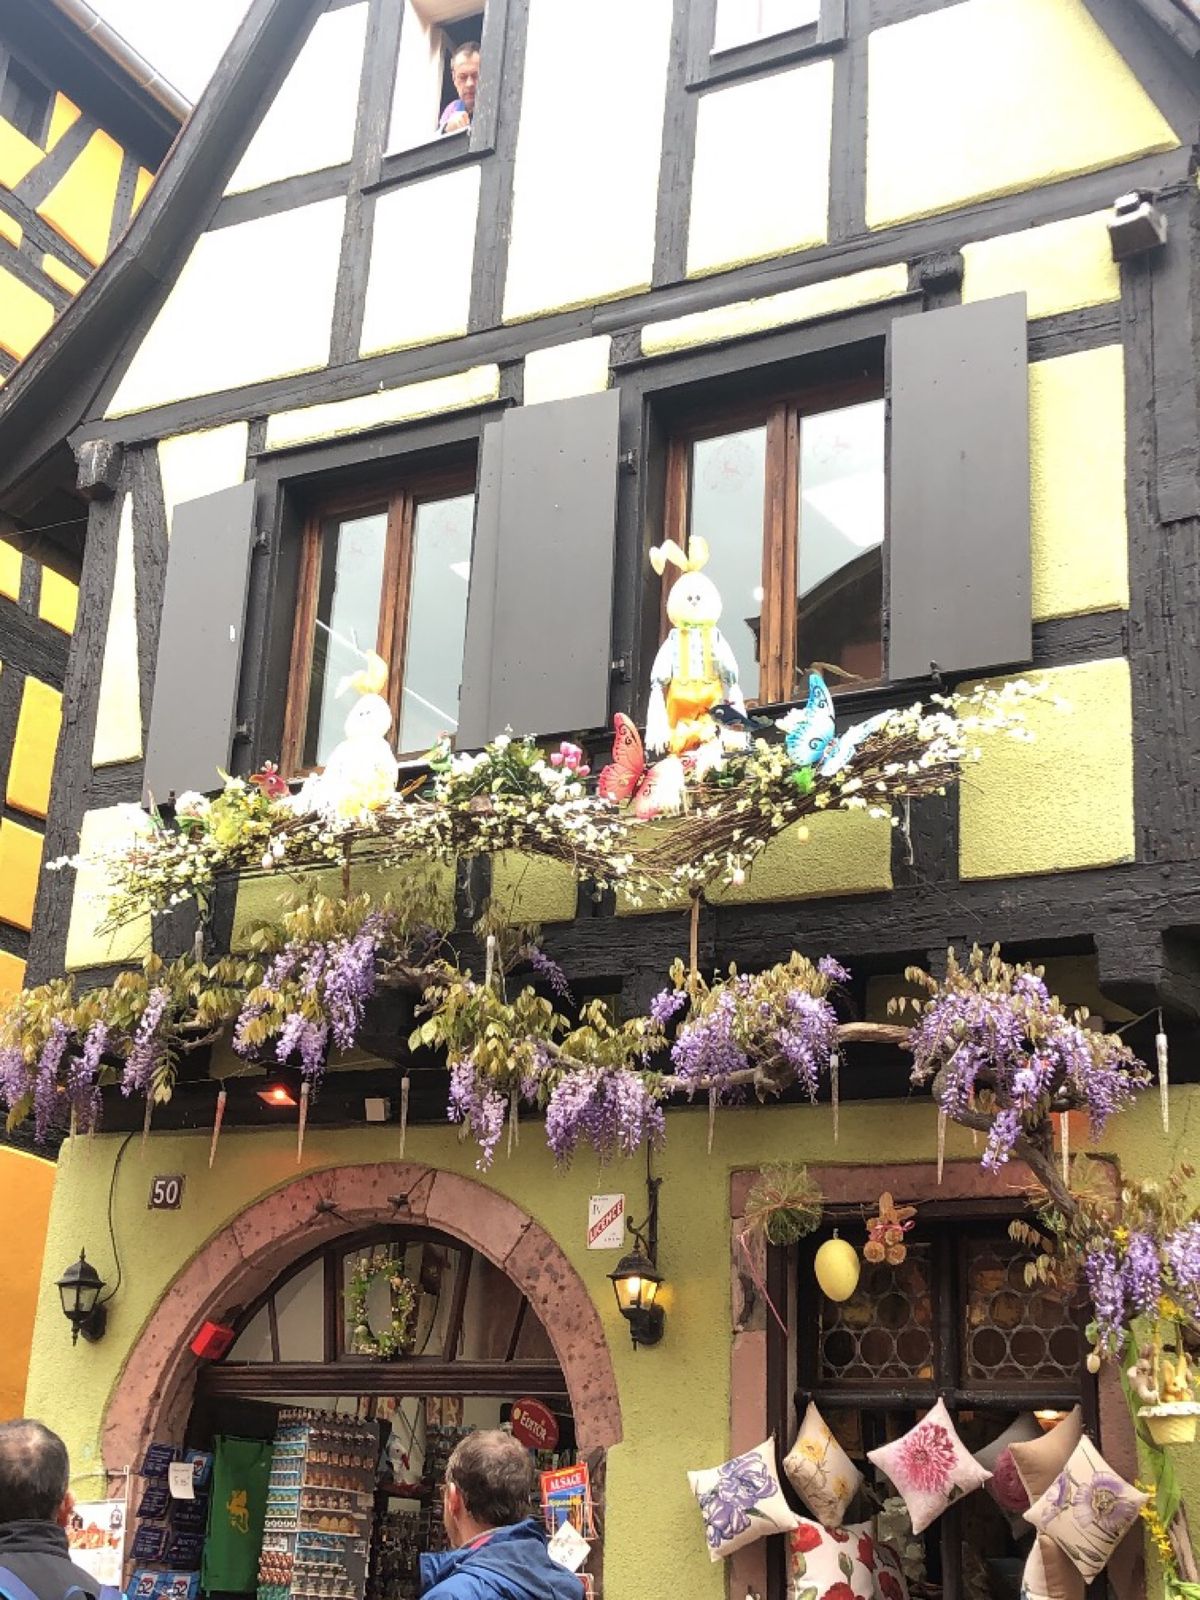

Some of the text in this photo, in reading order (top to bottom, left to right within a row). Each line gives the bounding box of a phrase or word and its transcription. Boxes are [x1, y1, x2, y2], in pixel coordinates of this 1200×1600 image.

[153, 1180, 179, 1204] 50
[590, 1202, 622, 1242] LICENCE
[550, 1472, 582, 1490] ALSACE
